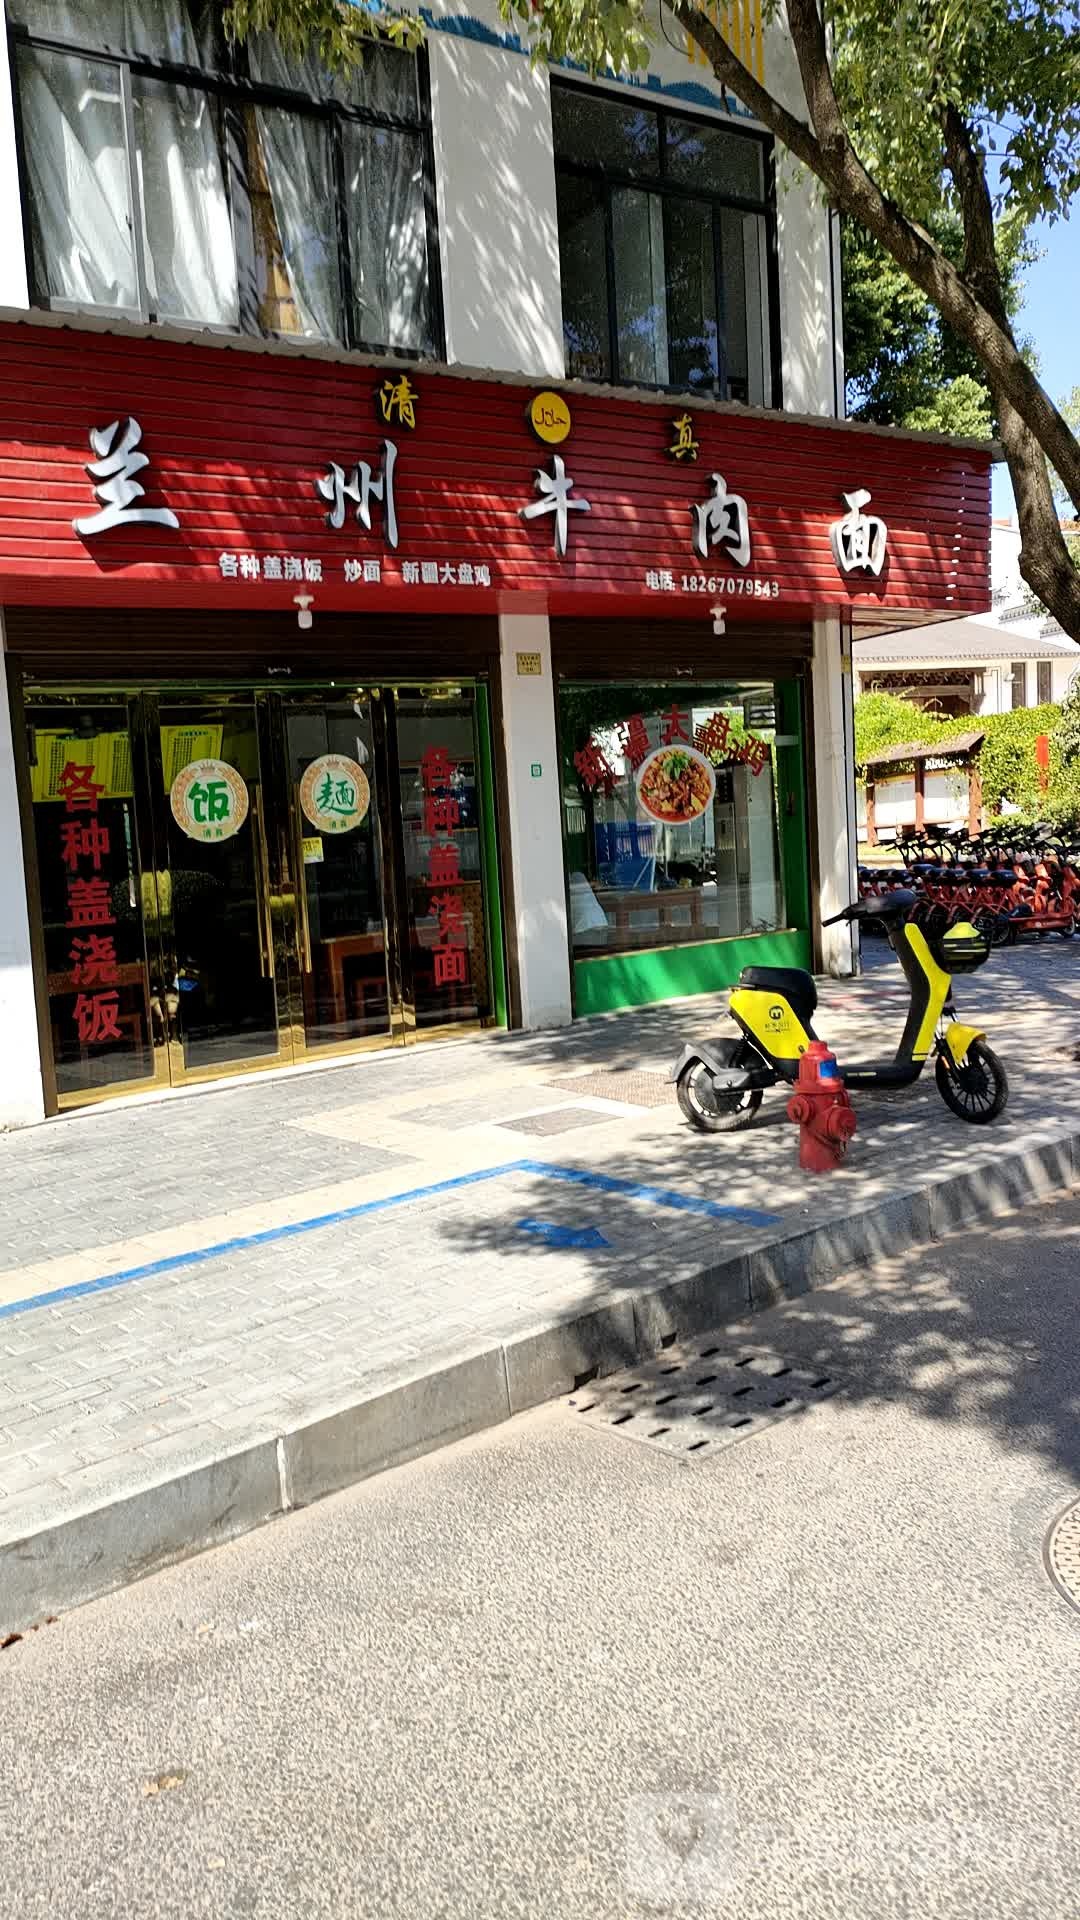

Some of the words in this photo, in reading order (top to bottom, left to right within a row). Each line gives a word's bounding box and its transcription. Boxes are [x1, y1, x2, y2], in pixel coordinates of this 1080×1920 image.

[379, 374, 420, 430] 清
[534, 407, 567, 428] حلال
[668, 412, 700, 461] 真
[73, 415, 888, 578] 兰州牛肉面
[218, 551, 324, 583] 各种盖浇饭
[343, 558, 381, 583] 炒面
[681, 574, 780, 598] 18267079543
[187, 780, 231, 824] 饭
[57, 760, 124, 1043] 各种盖浇饭
